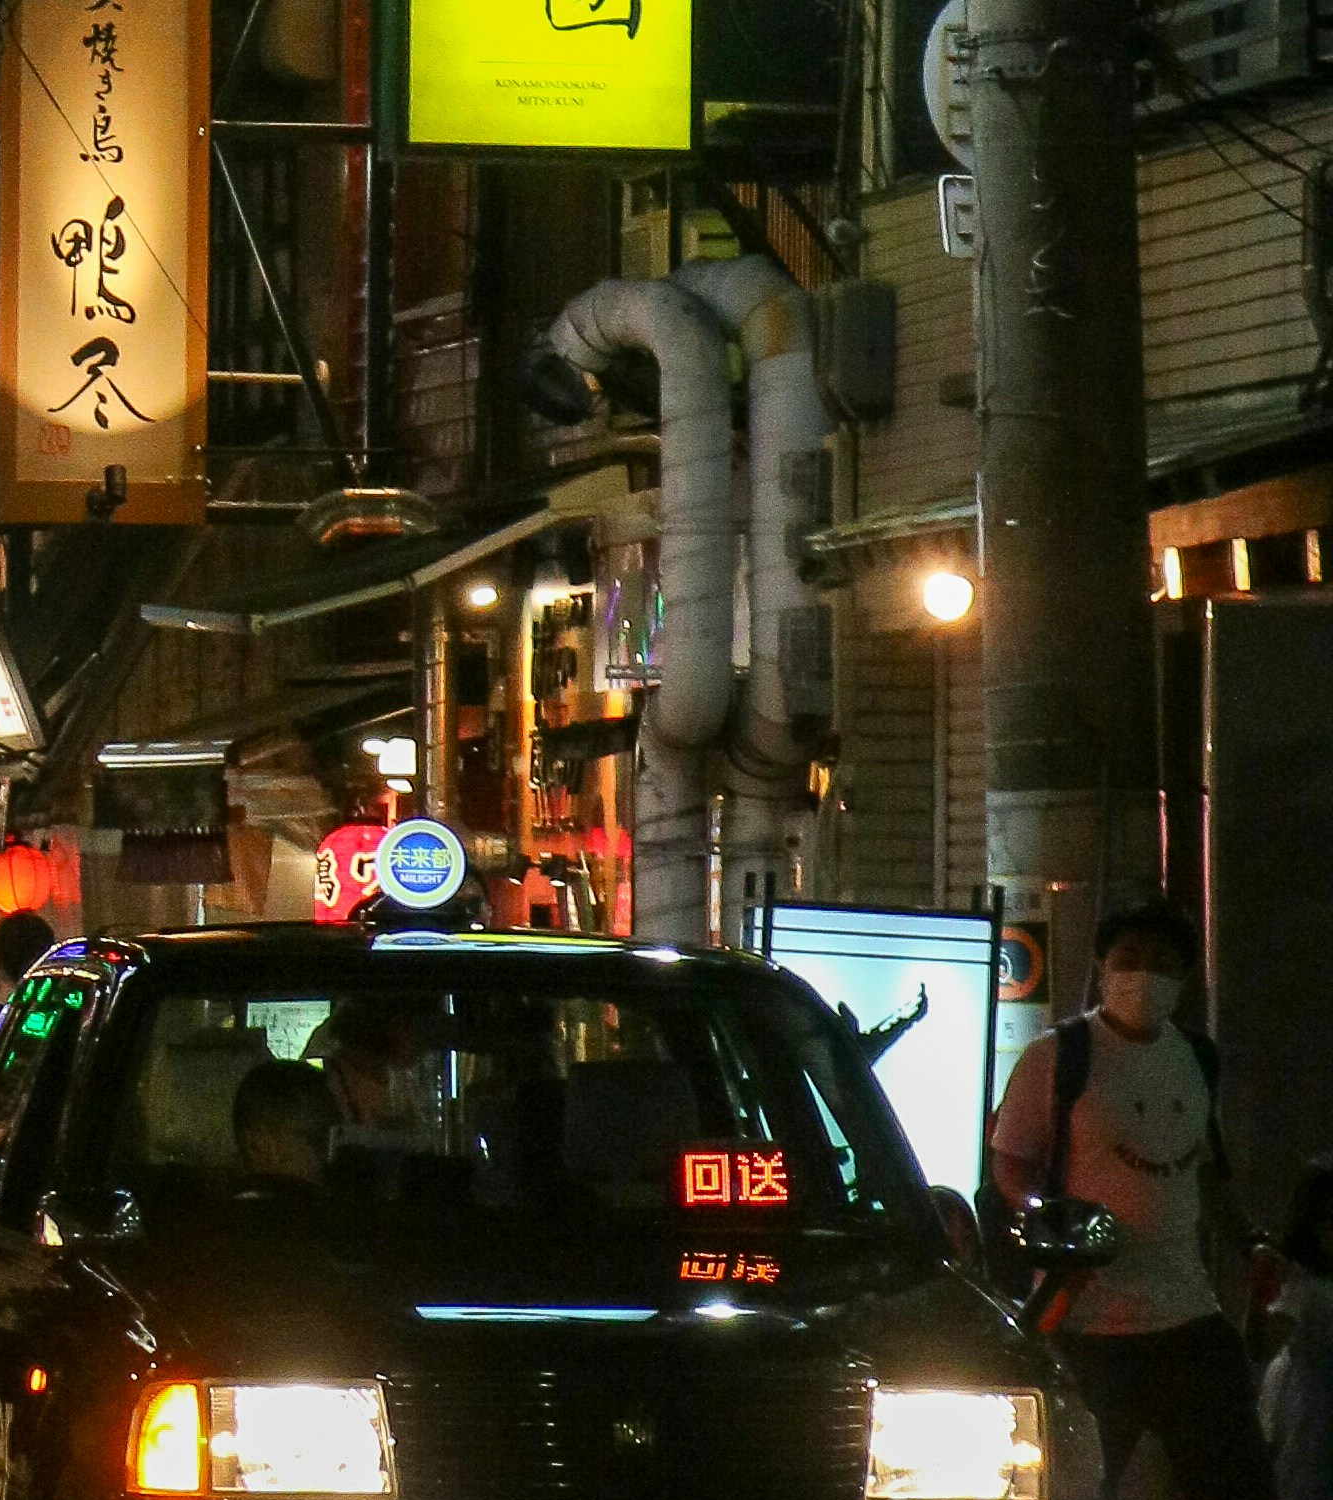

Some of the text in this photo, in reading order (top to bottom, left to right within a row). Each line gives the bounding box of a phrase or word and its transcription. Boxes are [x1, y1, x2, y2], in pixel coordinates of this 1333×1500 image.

[390, 846, 453, 869] 未来都
[678, 1150, 791, 1207] 回送
